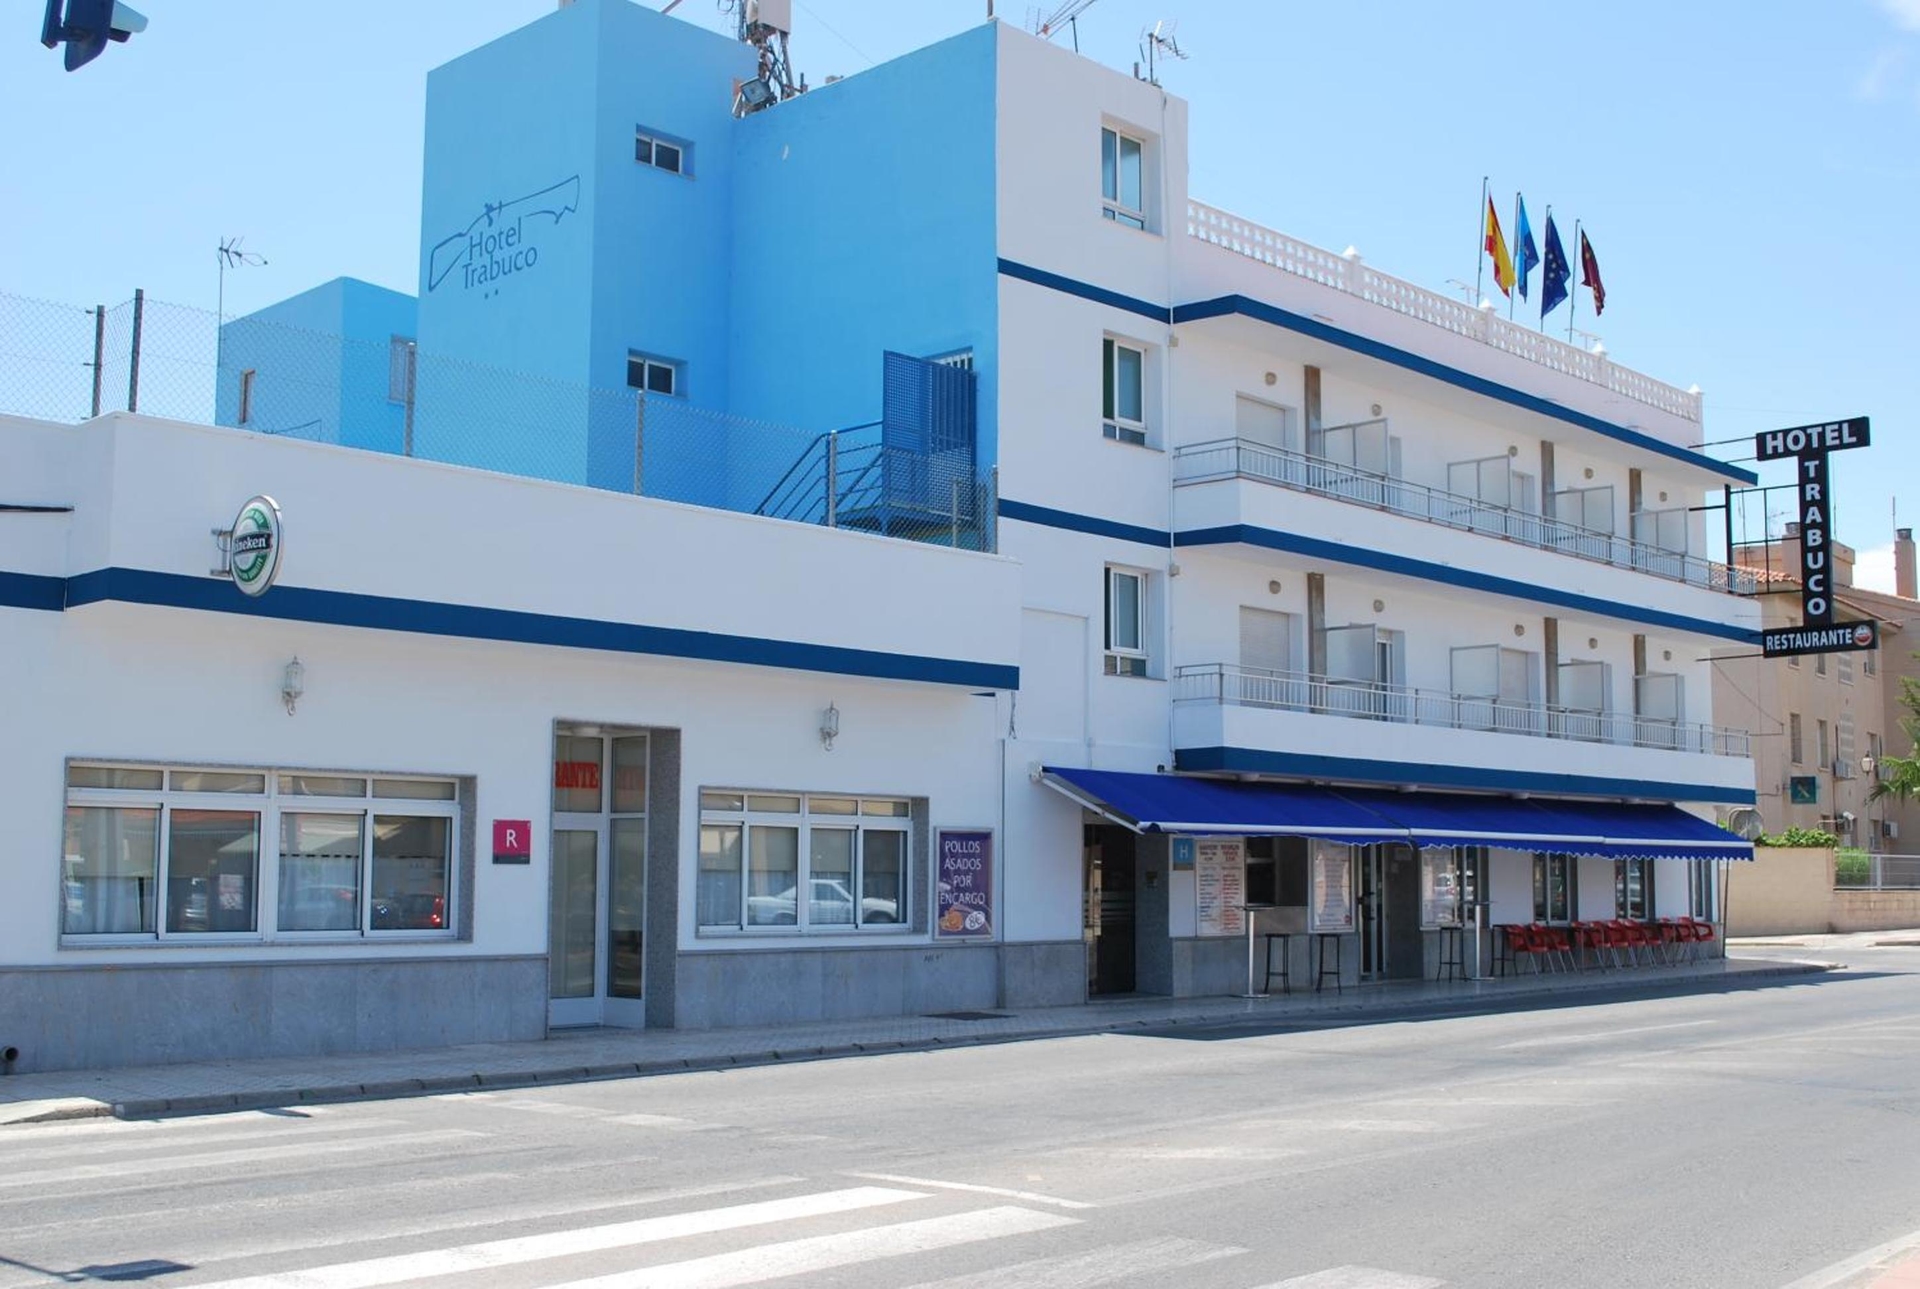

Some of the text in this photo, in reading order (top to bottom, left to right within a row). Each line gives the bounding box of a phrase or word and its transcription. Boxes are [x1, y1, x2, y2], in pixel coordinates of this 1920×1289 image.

[469, 216, 522, 261] Hotel
[462, 247, 538, 289] Trabuco
[1765, 422, 1857, 454] HOTEL
[1804, 460, 1827, 615] TRABUCO
[1766, 628, 1853, 650] RESTAURANTE
[506, 829, 518, 848] R
[945, 841, 980, 853] POLLOS
[1180, 844, 1189, 859] H
[944, 858, 982, 870] ASADOS
[953, 875, 972, 887] POR
[940, 892, 985, 904] ENCARGO
